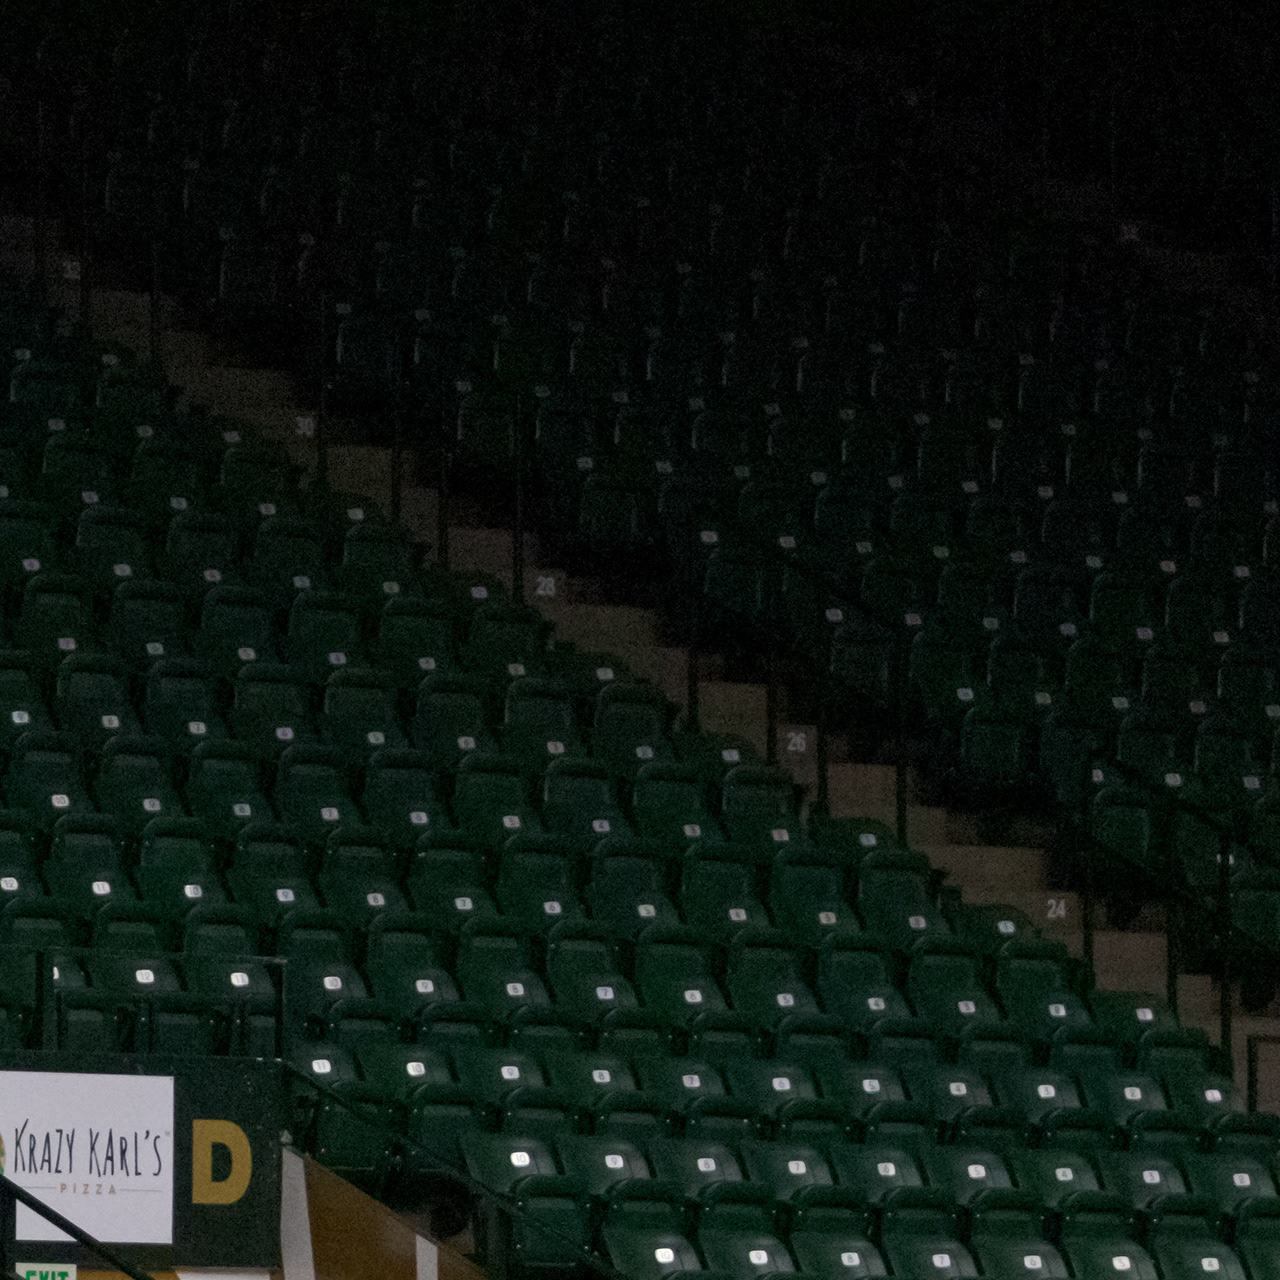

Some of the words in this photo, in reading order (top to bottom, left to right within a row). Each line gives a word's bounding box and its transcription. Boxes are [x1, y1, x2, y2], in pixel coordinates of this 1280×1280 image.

[1047, 899, 1066, 918] 24
[14, 1118, 75, 1174] KRAZY
[192, 1119, 252, 1205] D
[60, 1183, 117, 1195] PIZZA
